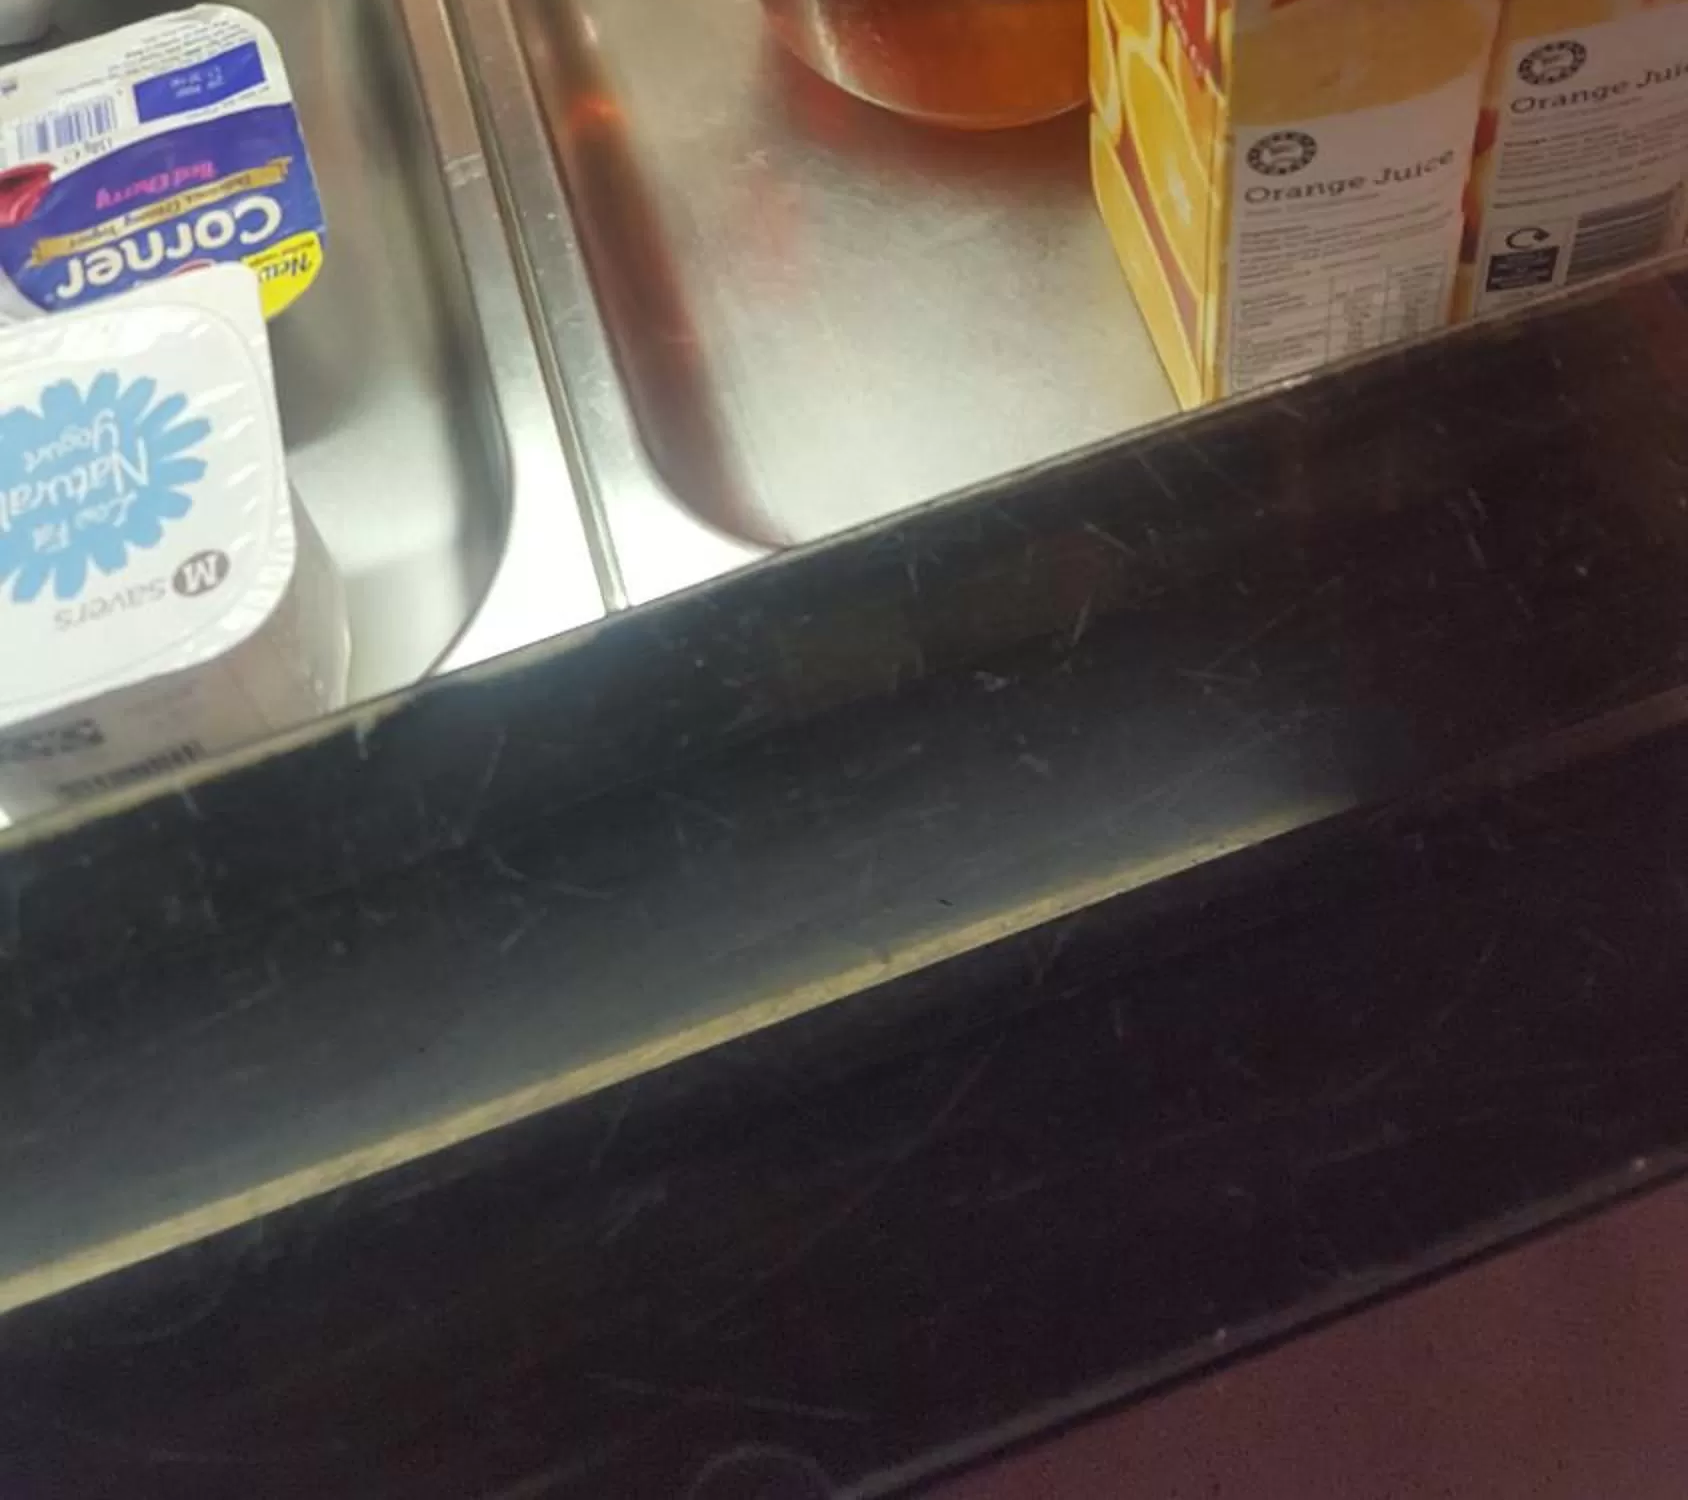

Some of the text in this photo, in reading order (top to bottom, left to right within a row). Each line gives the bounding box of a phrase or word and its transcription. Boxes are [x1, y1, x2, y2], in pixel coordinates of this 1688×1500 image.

[1511, 80, 1630, 114] Orange
[1244, 149, 1453, 204] Orange Juice
[55, 195, 282, 299] Corner
[22, 407, 119, 474] Yogurt
[0, 436, 149, 533] Natural
[54, 577, 168, 632] savers
